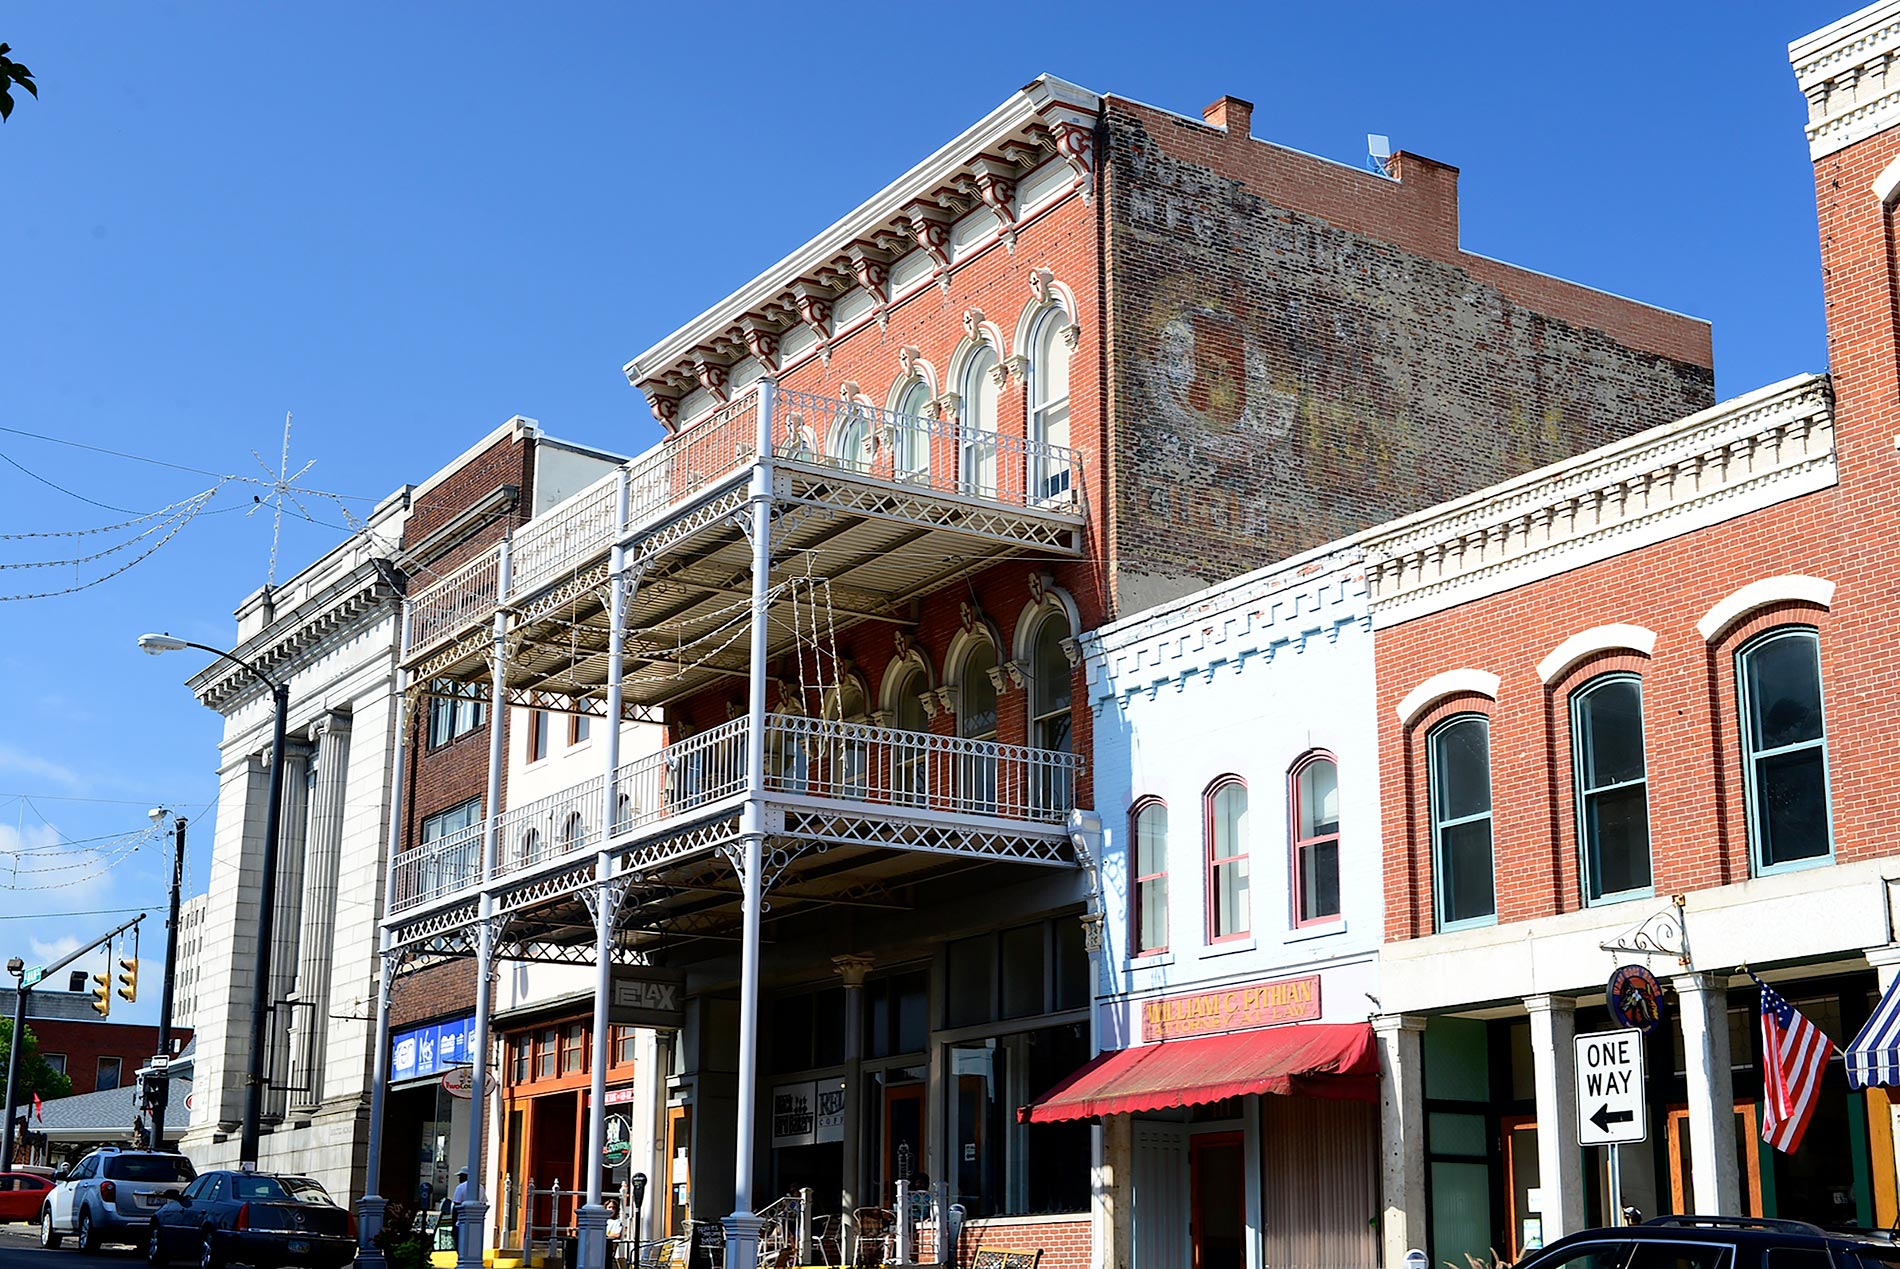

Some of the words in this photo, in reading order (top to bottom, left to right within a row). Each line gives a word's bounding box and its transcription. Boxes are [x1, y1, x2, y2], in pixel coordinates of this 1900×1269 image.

[1146, 994, 1220, 1025] WILLIAM
[1153, 1014, 1234, 1036] ATTORNEY
[1239, 1009, 1261, 1026] AT
[1272, 1003, 1308, 1020] LAW
[1587, 1040, 1631, 1068] ONE
[1587, 1069, 1632, 1097] WAY
[819, 1090, 845, 1116] REL
